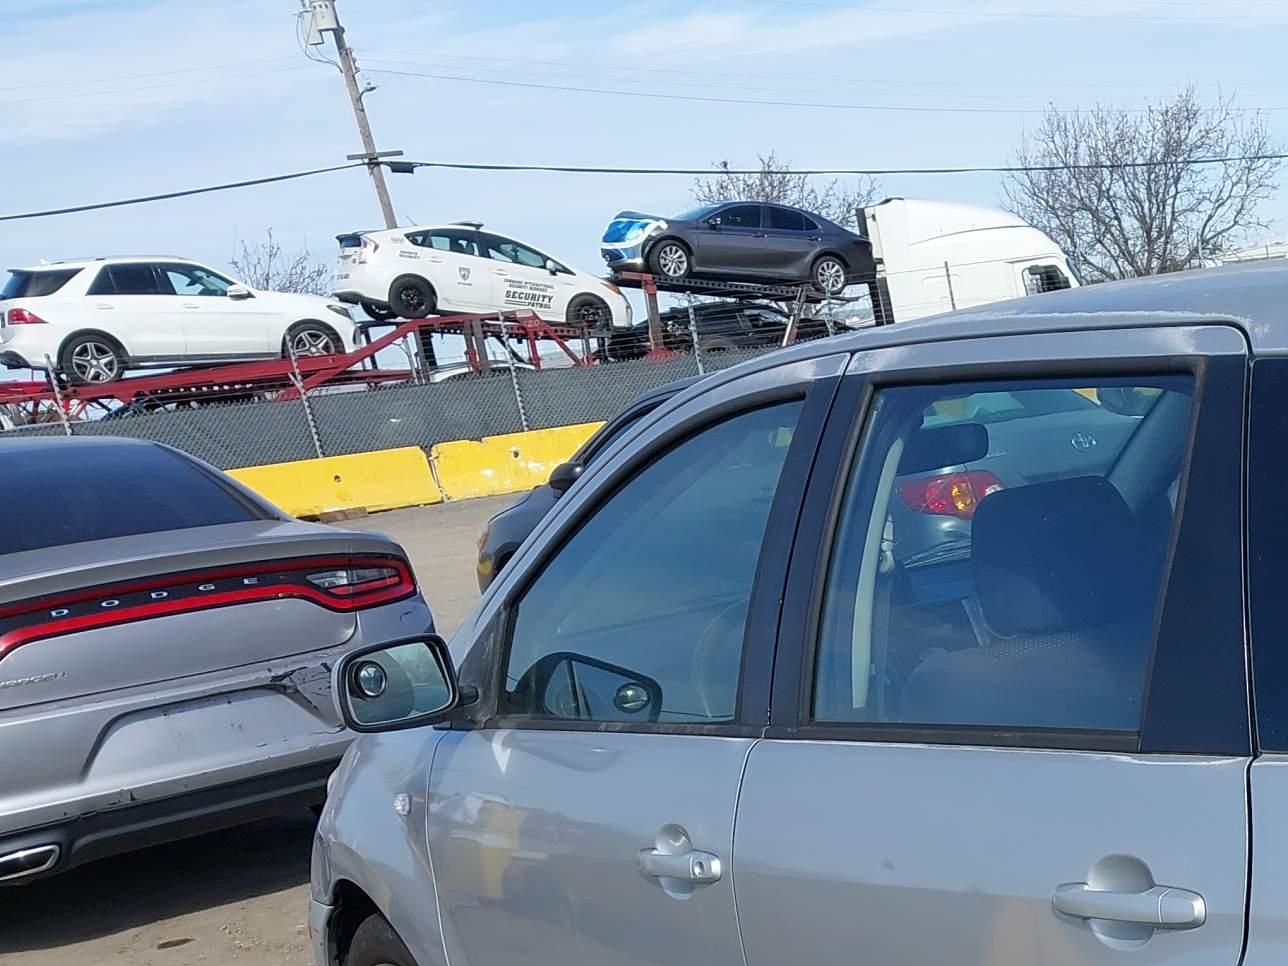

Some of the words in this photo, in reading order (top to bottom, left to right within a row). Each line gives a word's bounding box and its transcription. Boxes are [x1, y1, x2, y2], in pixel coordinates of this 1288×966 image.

[505, 290, 554, 303] SECURITY
[528, 301, 552, 309] PATROL
[50, 577, 259, 618] DODGE
